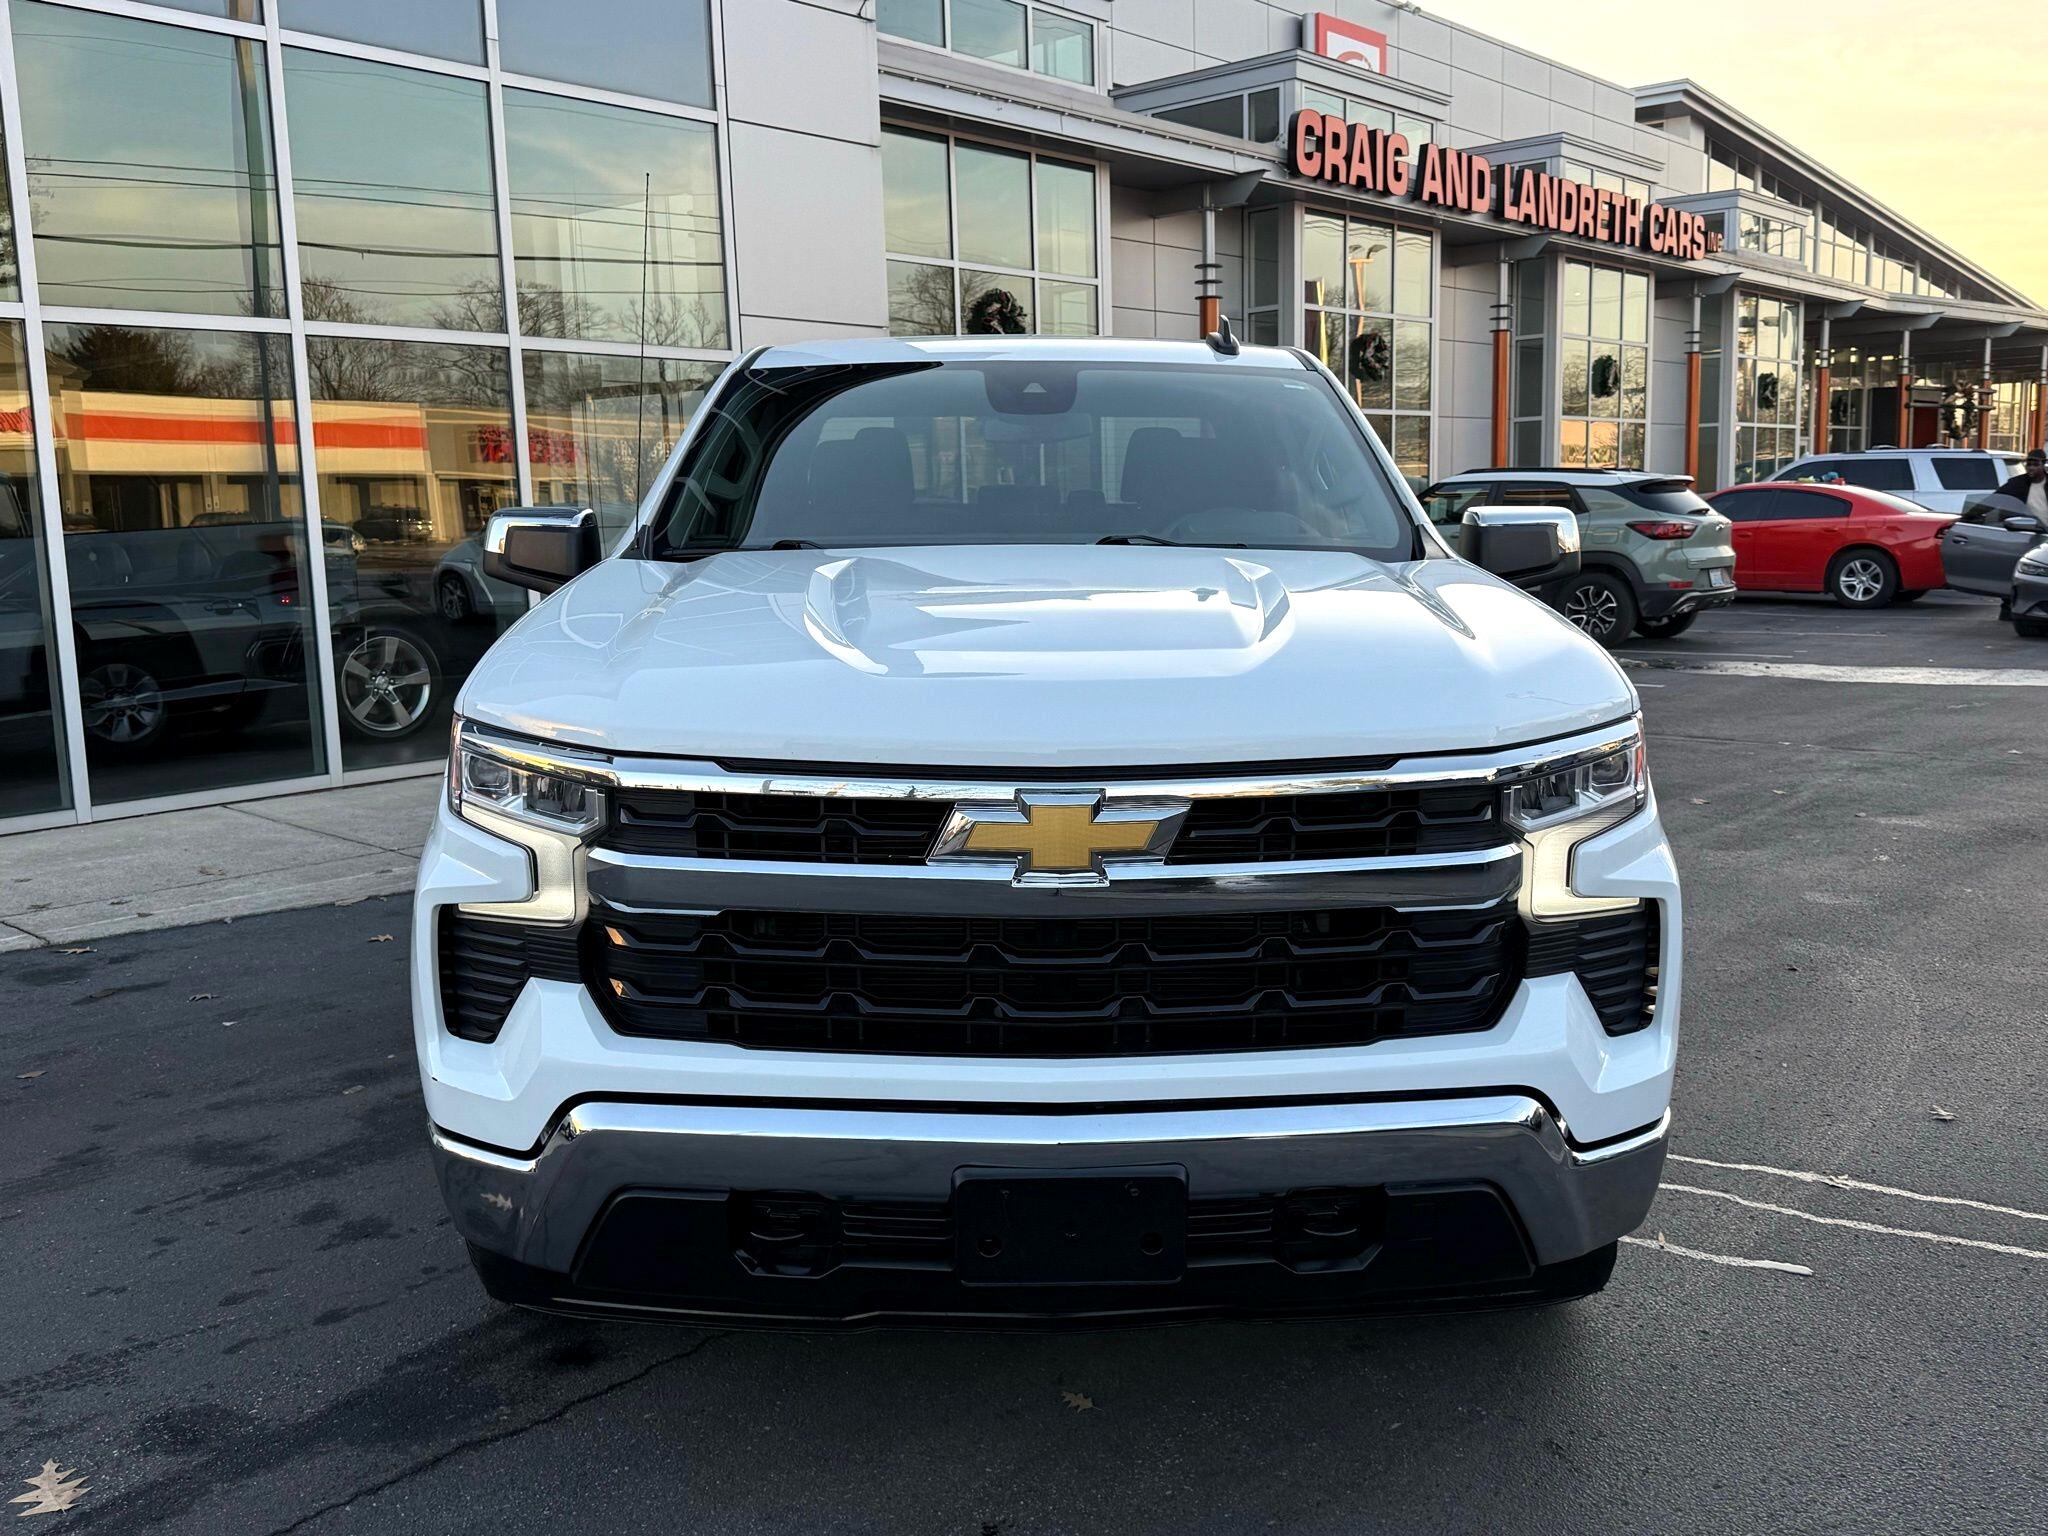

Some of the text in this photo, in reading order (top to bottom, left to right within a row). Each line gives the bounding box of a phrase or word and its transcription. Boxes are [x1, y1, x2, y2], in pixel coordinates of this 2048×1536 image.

[1295, 108, 1409, 196] CRAIG
[1422, 143, 1491, 214] AND
[1504, 163, 1641, 248] LANDRETH
[1650, 203, 1706, 260] CARS
